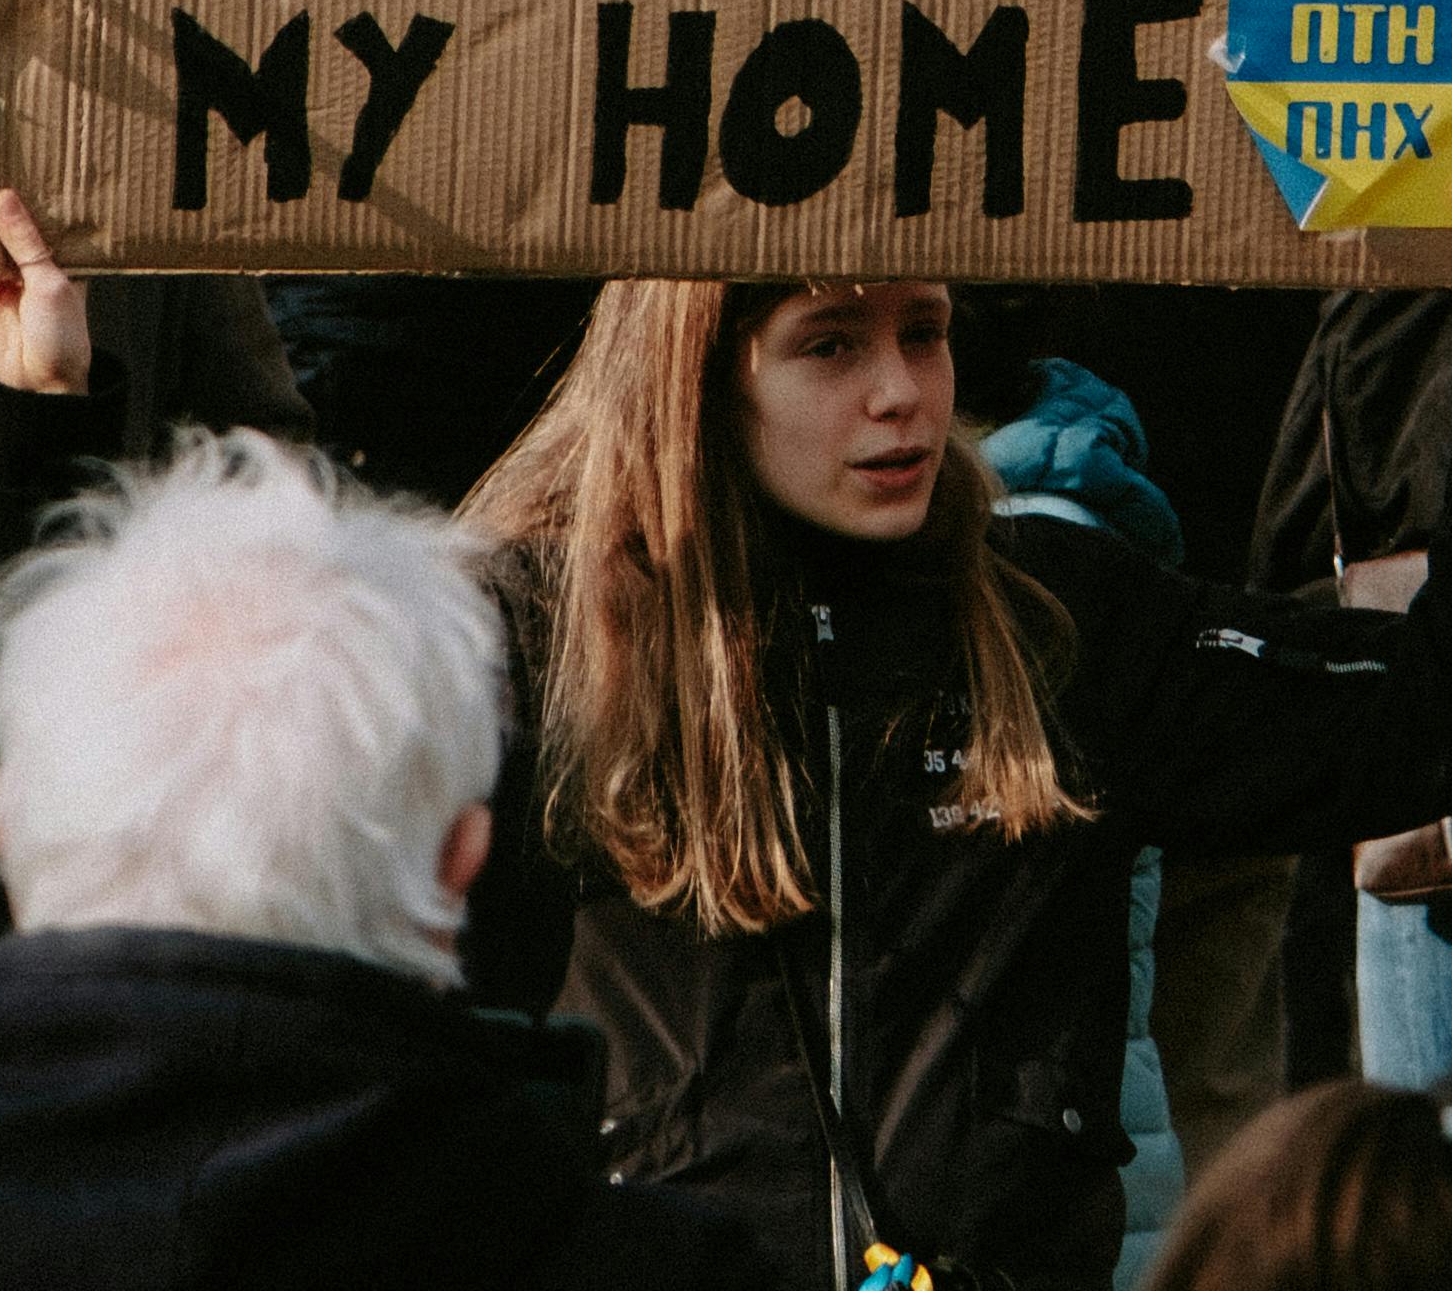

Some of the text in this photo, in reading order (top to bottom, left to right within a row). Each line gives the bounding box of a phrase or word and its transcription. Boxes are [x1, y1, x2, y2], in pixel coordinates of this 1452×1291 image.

[1290, 2, 1437, 65] ПТН
[170, 0, 456, 213] MY
[1284, 100, 1434, 161] ПНХ
